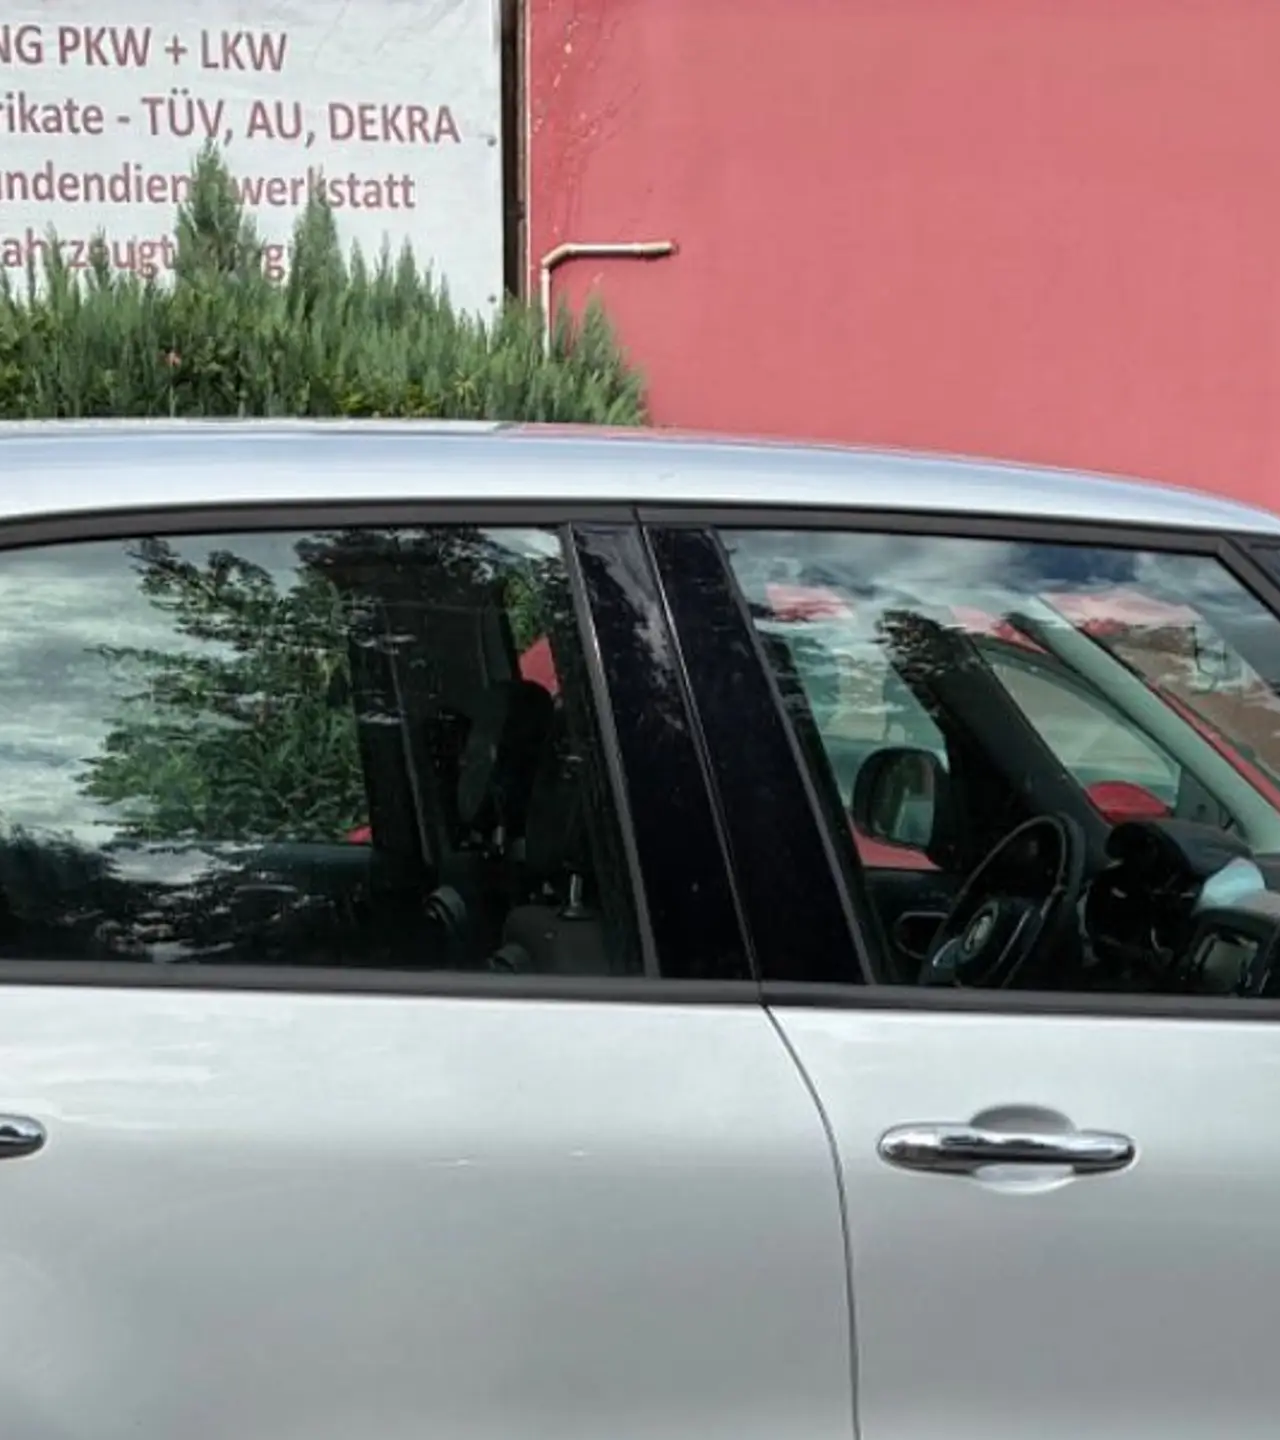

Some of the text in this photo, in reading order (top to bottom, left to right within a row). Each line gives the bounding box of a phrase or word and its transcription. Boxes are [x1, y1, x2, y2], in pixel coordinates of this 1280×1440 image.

[58, 26, 152, 67] PKW
[164, 35, 188, 65] +
[201, 29, 287, 72] LKW
[141, 88, 233, 146] TÜV,
[246, 100, 315, 148] AU,
[328, 102, 461, 144] DEKRA
